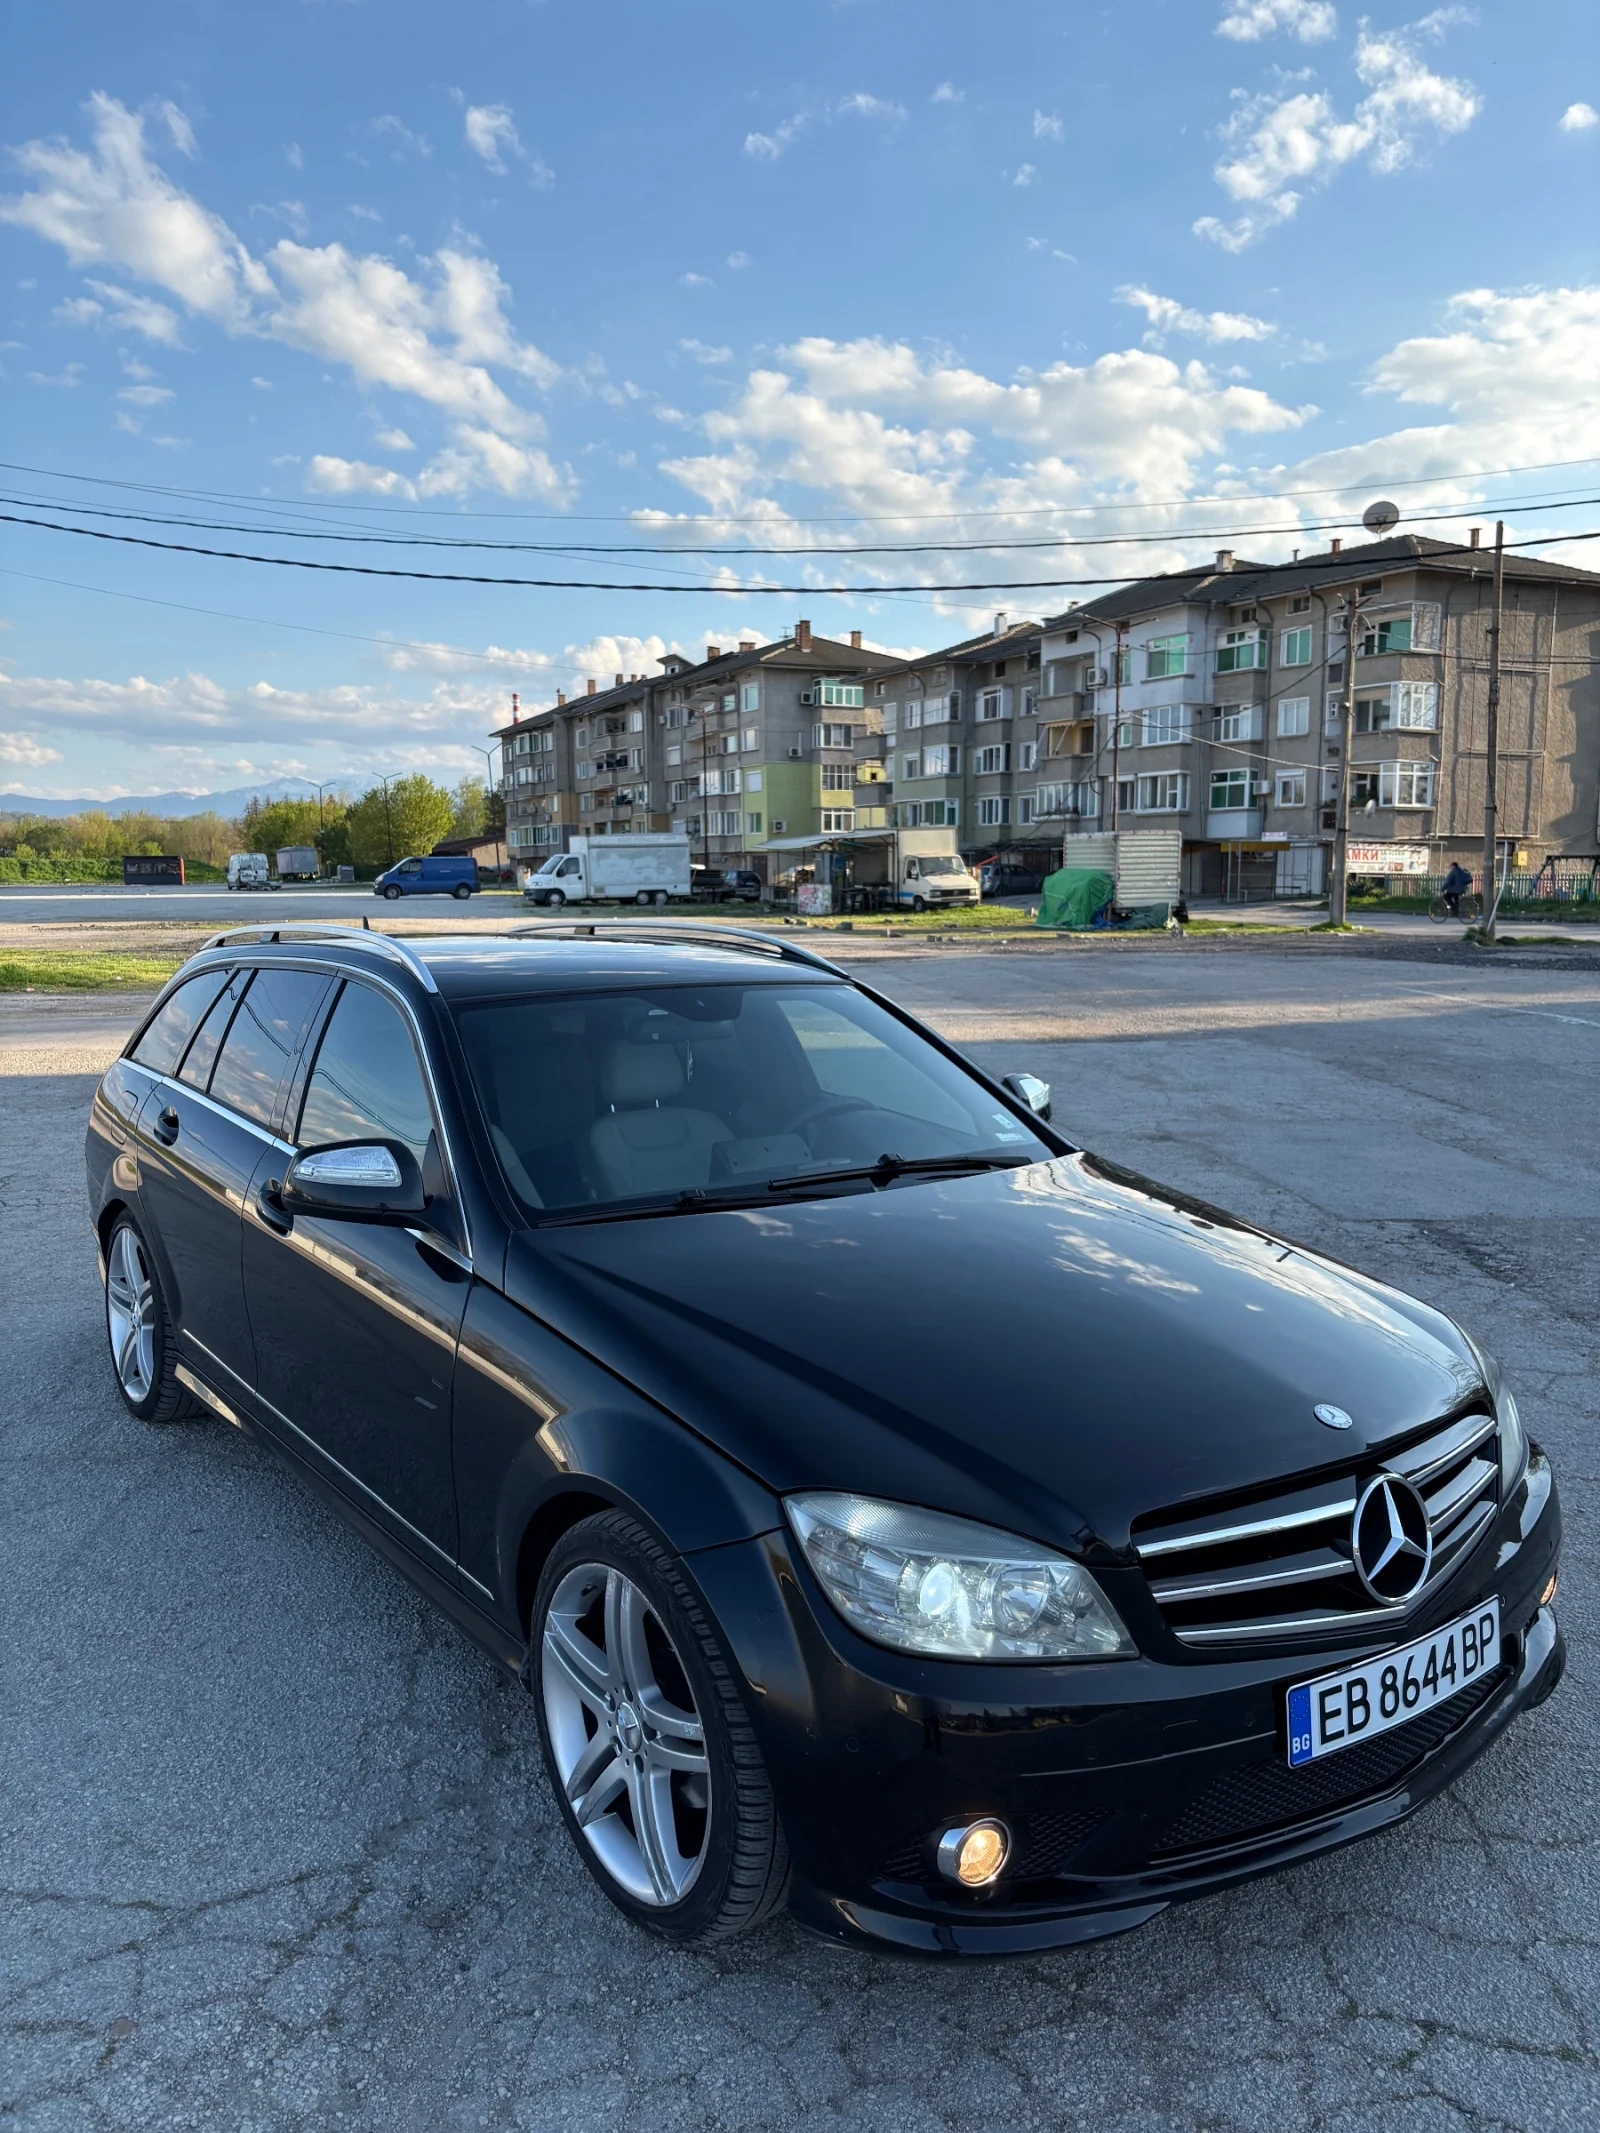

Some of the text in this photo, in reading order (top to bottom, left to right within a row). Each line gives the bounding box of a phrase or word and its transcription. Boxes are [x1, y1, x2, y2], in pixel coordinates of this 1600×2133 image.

[1345, 849, 1379, 861] АМКИ
[1318, 1612, 1495, 1745] EB 8644 BP
[1292, 1733, 1310, 1754] BG
